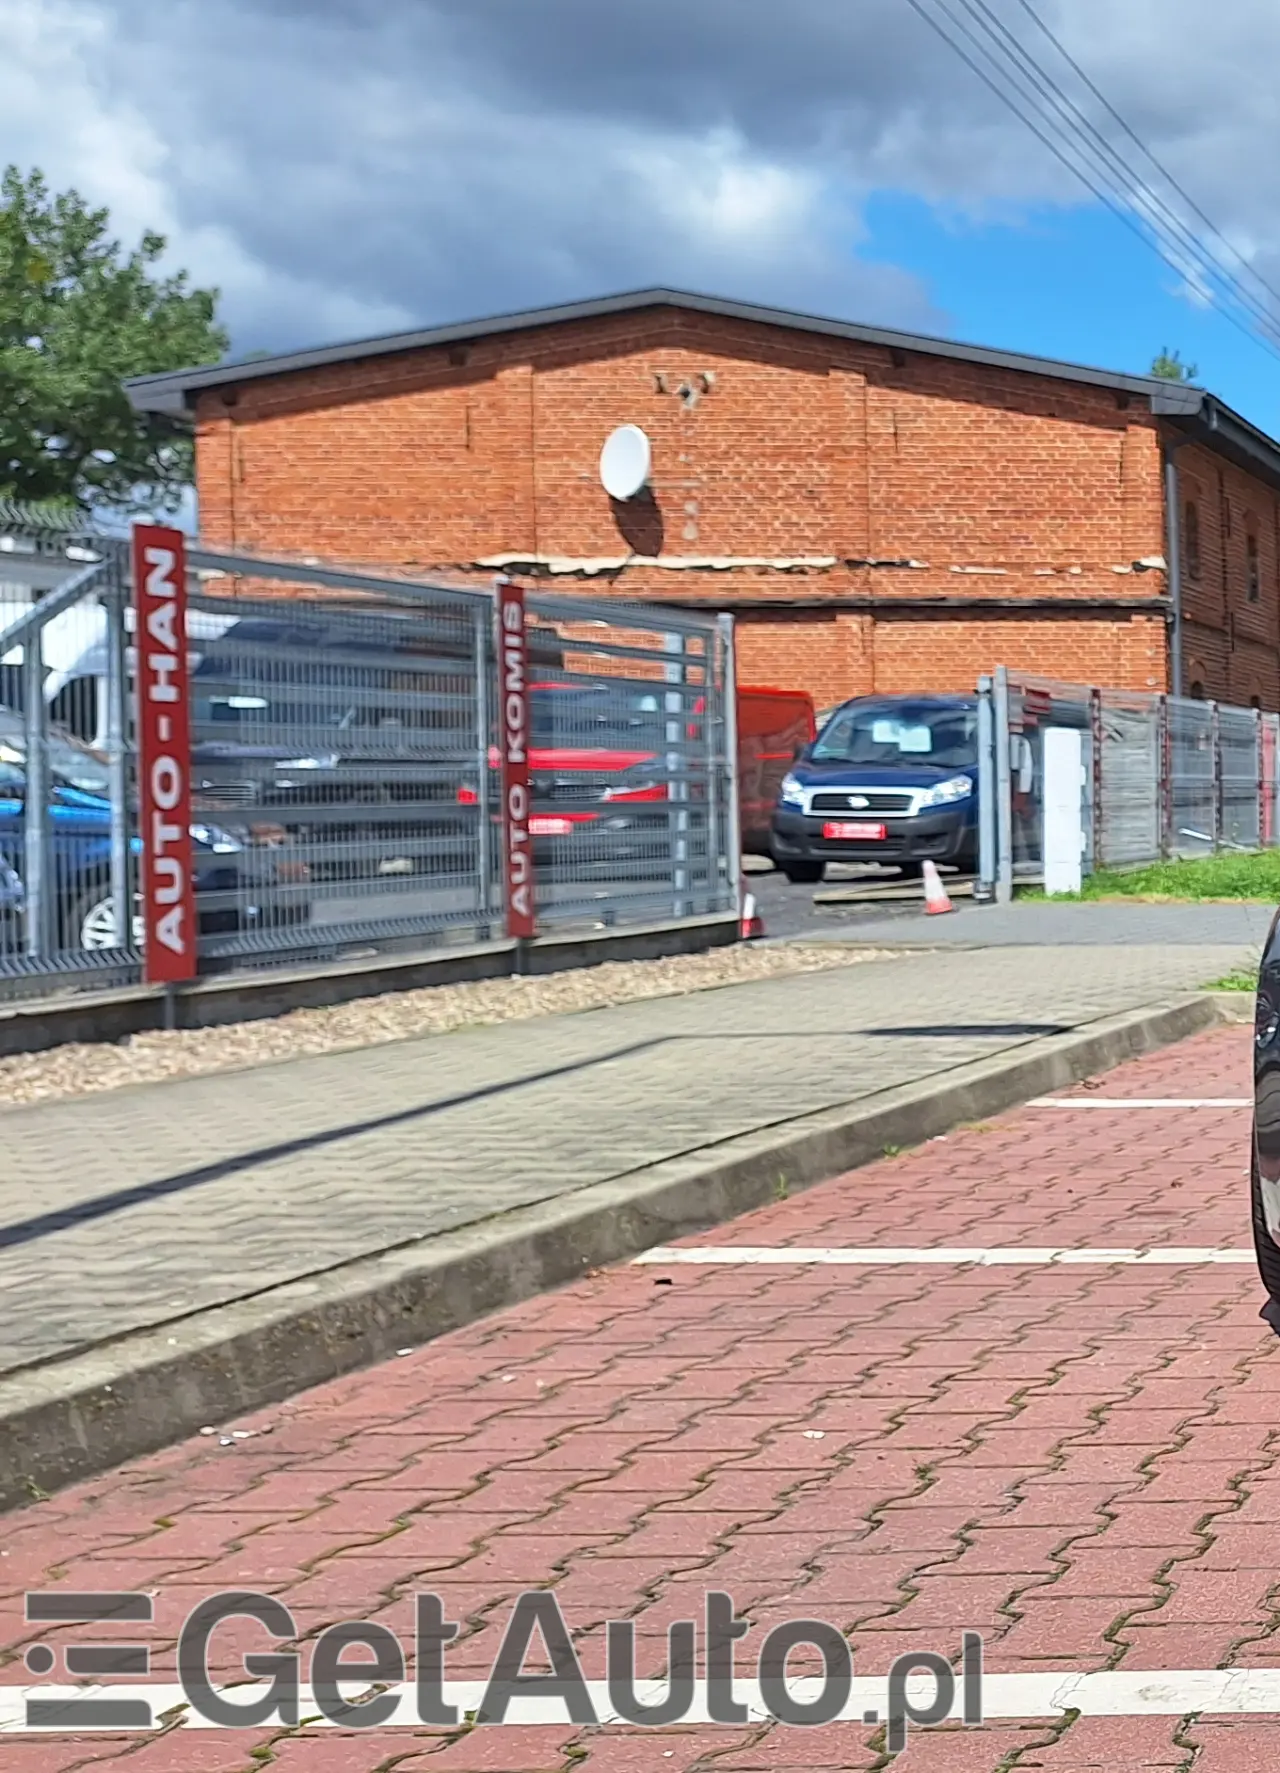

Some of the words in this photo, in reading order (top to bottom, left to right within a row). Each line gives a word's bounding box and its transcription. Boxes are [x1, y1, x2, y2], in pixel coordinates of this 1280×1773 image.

[145, 546, 178, 703] HAN
[503, 600, 526, 763] KOMIS
[150, 754, 186, 955] AUTO
[509, 783, 531, 917] AUTO
